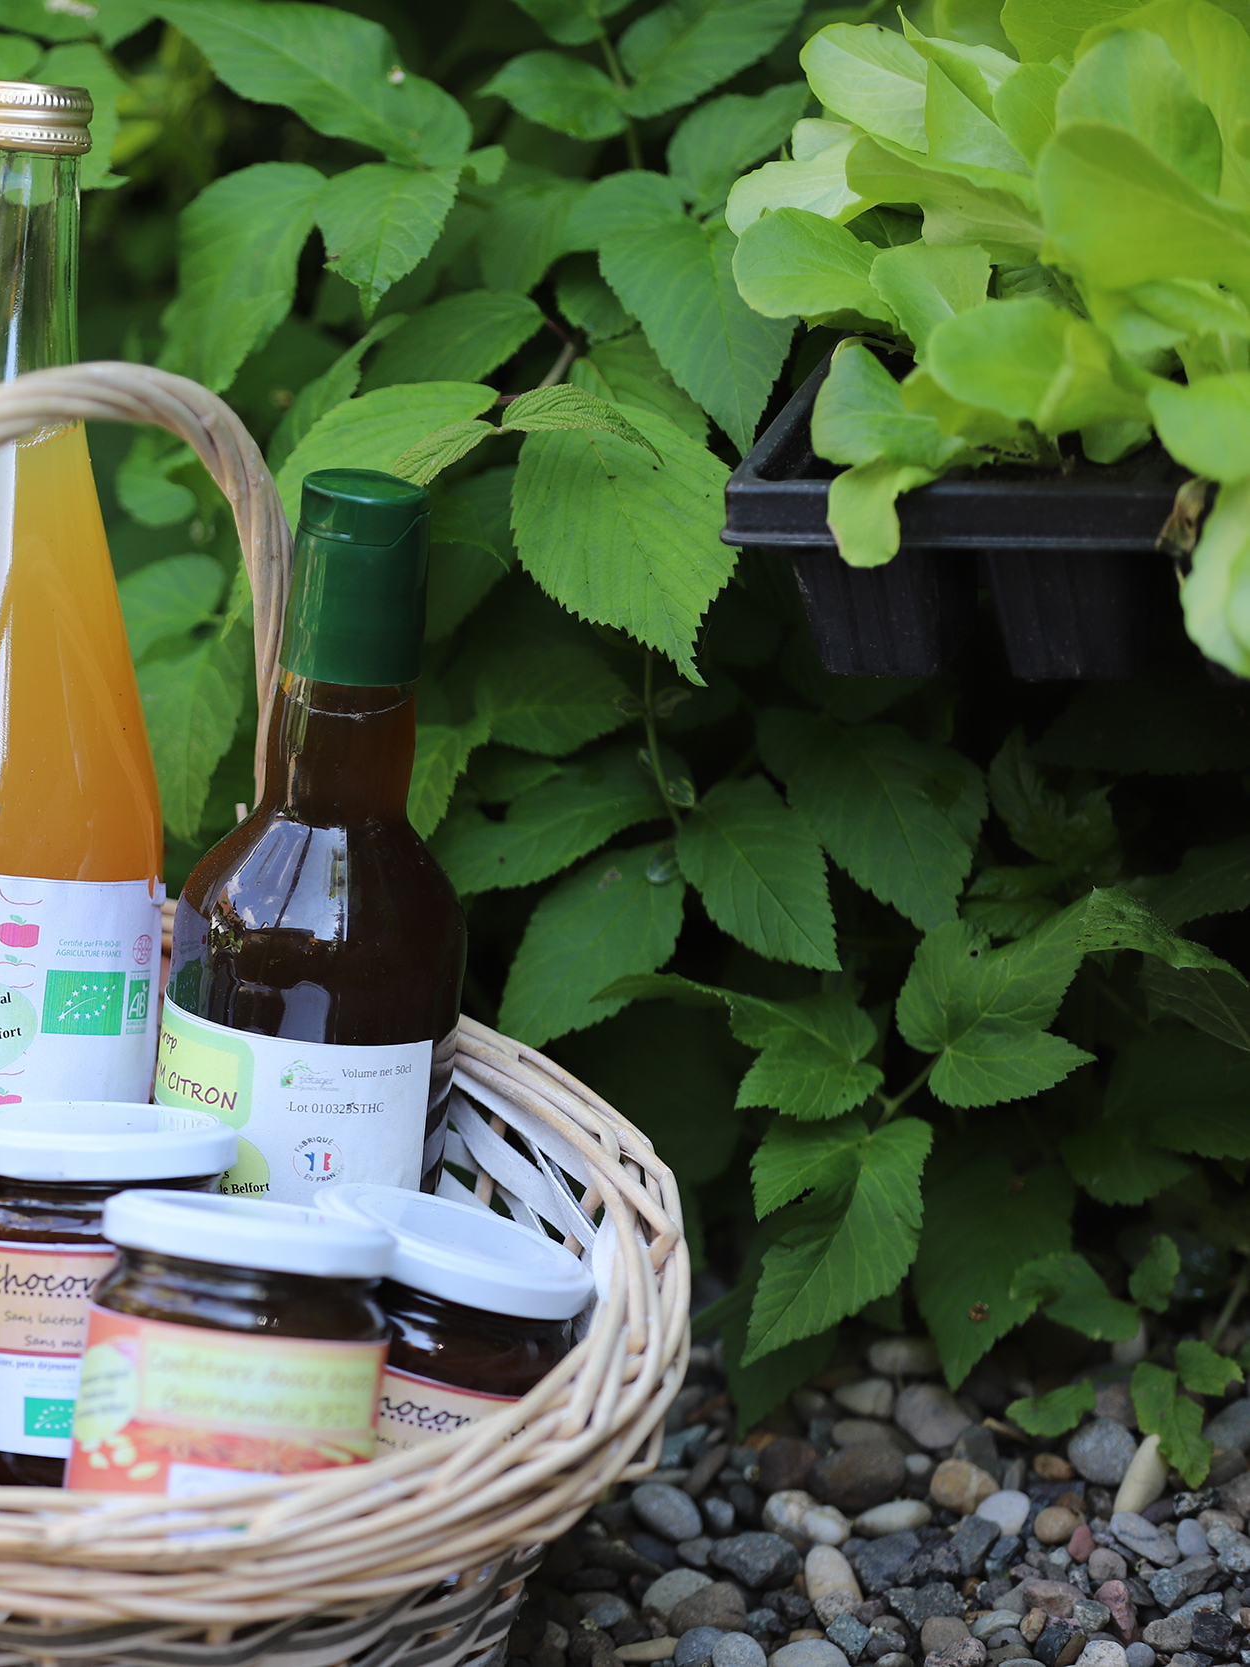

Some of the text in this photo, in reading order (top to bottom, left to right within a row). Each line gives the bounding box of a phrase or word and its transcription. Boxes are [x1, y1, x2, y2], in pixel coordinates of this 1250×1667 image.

[58, 938, 83, 947] Certifié
[84, 940, 95, 949] par
[56, 948, 122, 958] AGRICULTURE FRANCE
[341, 1063, 412, 1079] Volume net 50cl
[168, 1071, 238, 1110] CITRON
[303, 1173, 314, 1182] EN
[231, 1181, 271, 1196] Belfort
